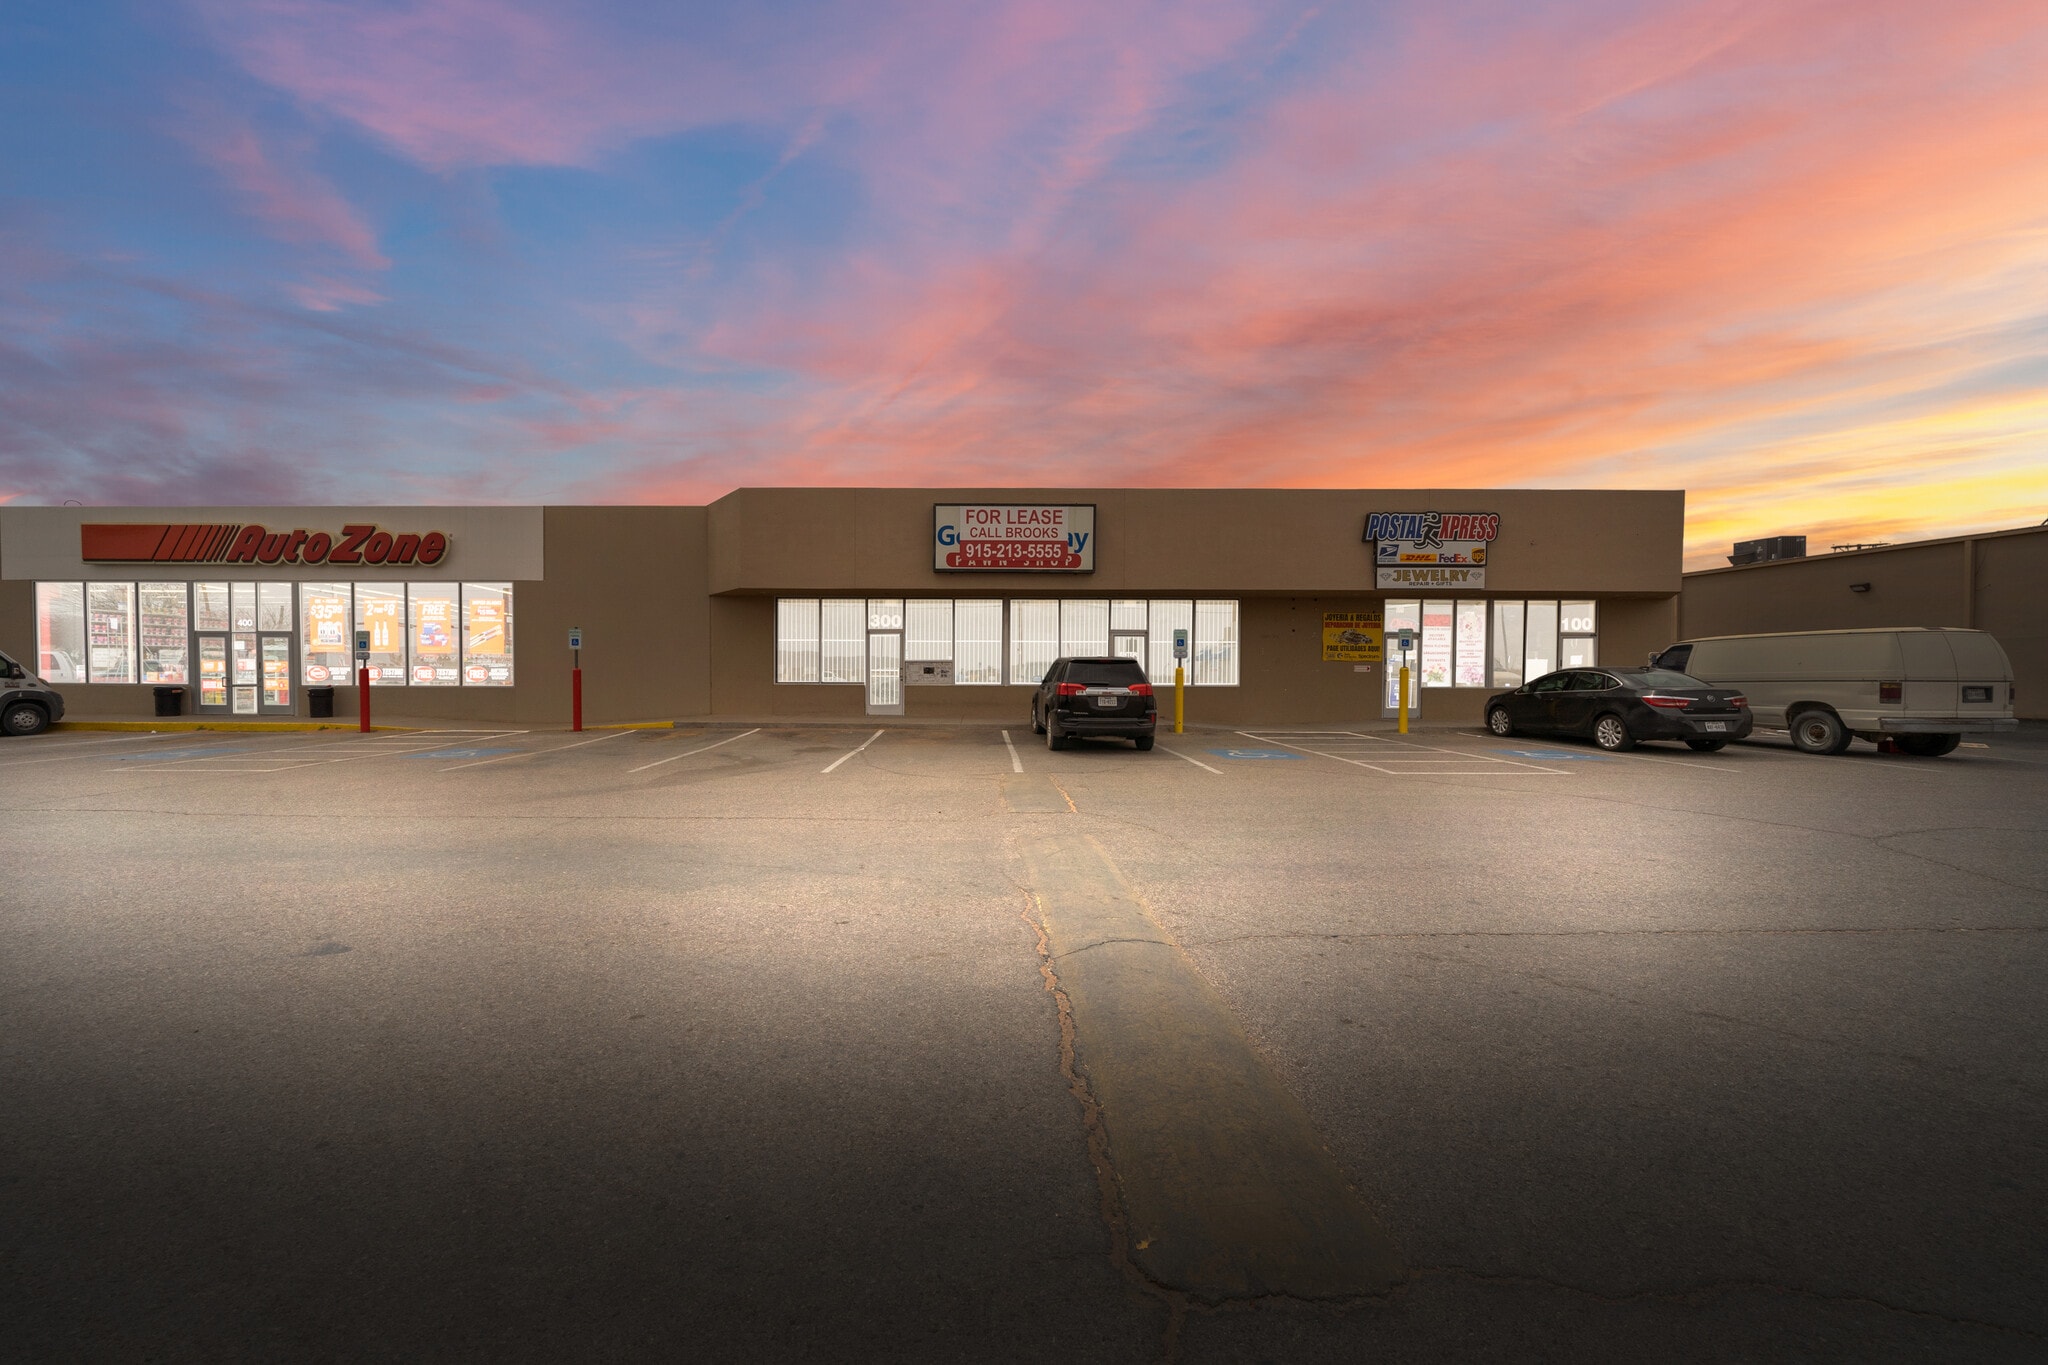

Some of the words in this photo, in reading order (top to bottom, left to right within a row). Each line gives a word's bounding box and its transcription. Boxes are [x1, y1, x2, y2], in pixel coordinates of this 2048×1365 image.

[966, 509, 1001, 525] FOR
[1007, 509, 1063, 525] LEASE
[970, 527, 1002, 538] CALL
[1005, 527, 1059, 539] BROOKS
[1366, 514, 1424, 539] POSTAL
[1438, 514, 1498, 540] XPRESS
[226, 525, 447, 564] AutoZone
[966, 543, 1062, 558] 915-213-5555
[1439, 553, 1468, 563] FedEx
[1392, 570, 1471, 582] JEWELRY
[422, 604, 445, 615] FREE
[237, 619, 253, 627] 400
[870, 614, 902, 627] 300
[1562, 617, 1593, 631] 100
[417, 669, 433, 679] FREE
[469, 669, 485, 679] FREE
